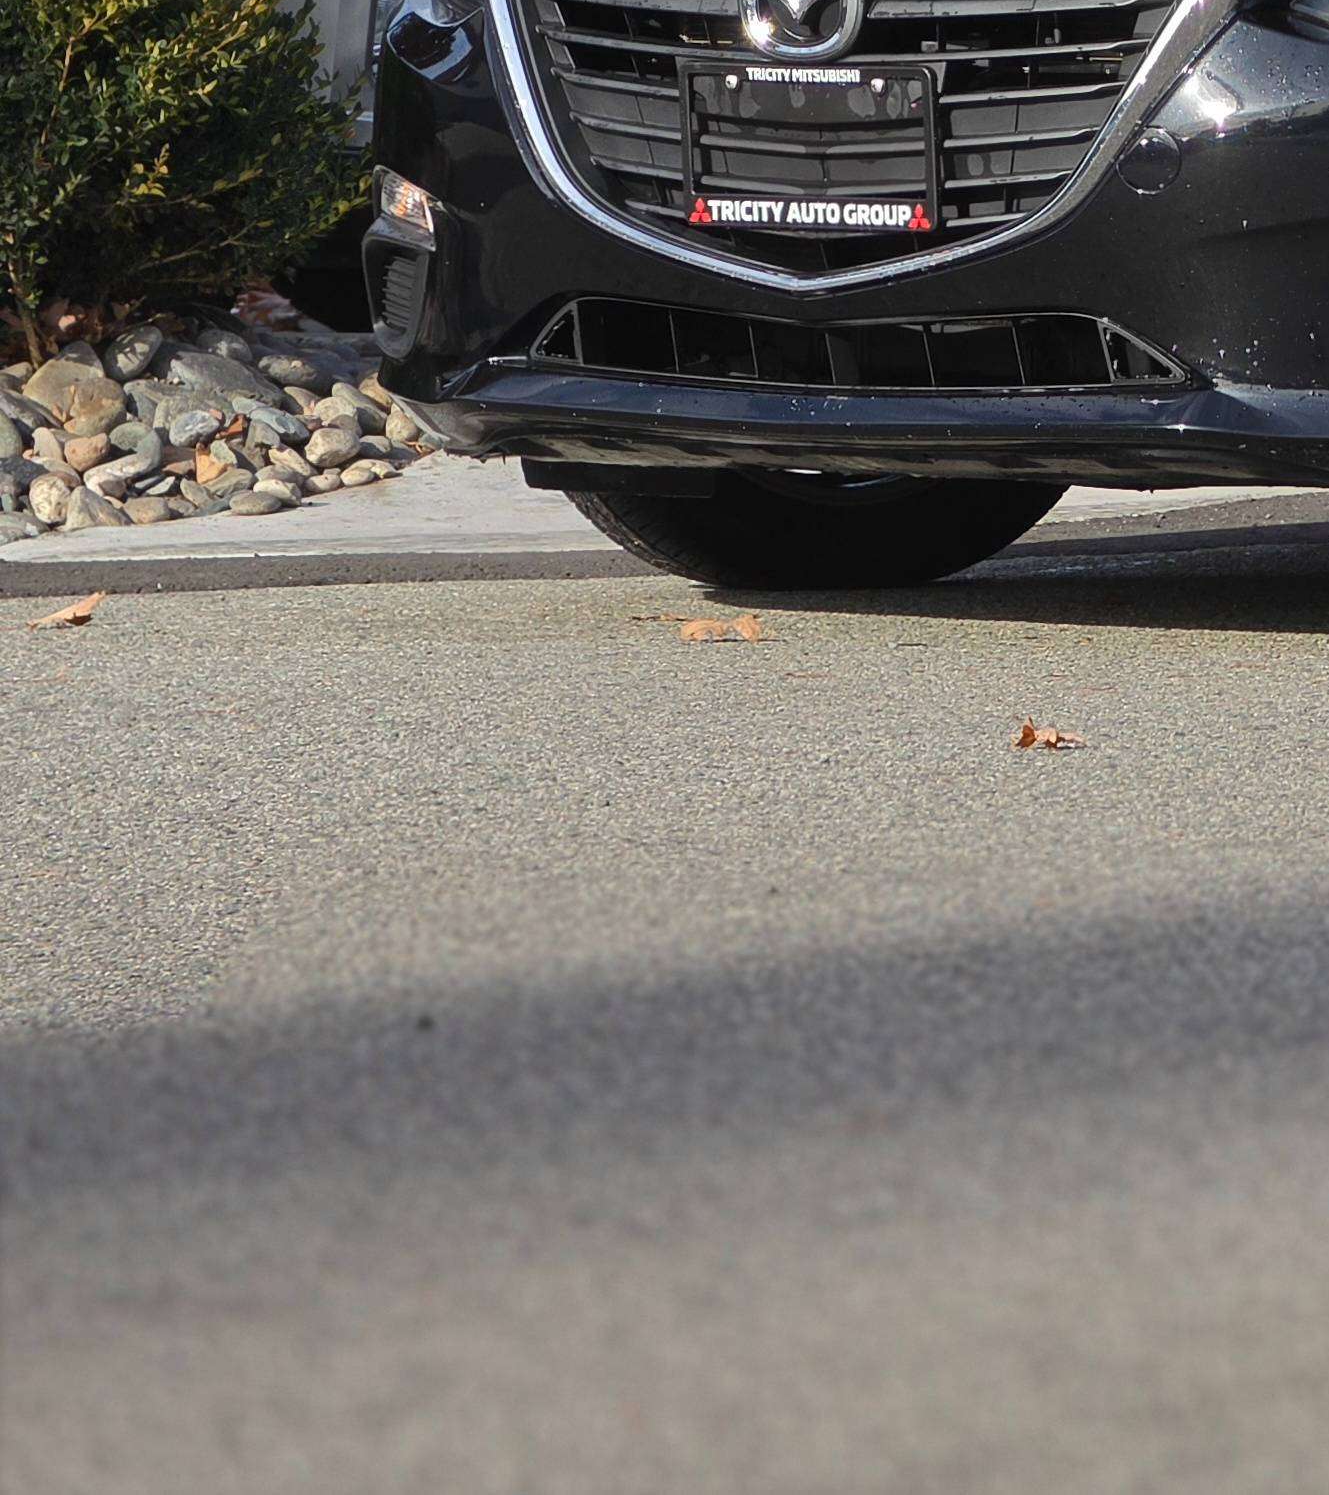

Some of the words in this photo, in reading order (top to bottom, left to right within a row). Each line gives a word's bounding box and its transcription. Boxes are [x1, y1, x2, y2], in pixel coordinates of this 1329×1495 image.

[746, 67, 791, 82] TRICITY
[791, 69, 860, 83] MITSUBISHI
[707, 200, 785, 223] TRICITY
[786, 202, 842, 224] AUTO
[843, 204, 912, 226] GROUP
